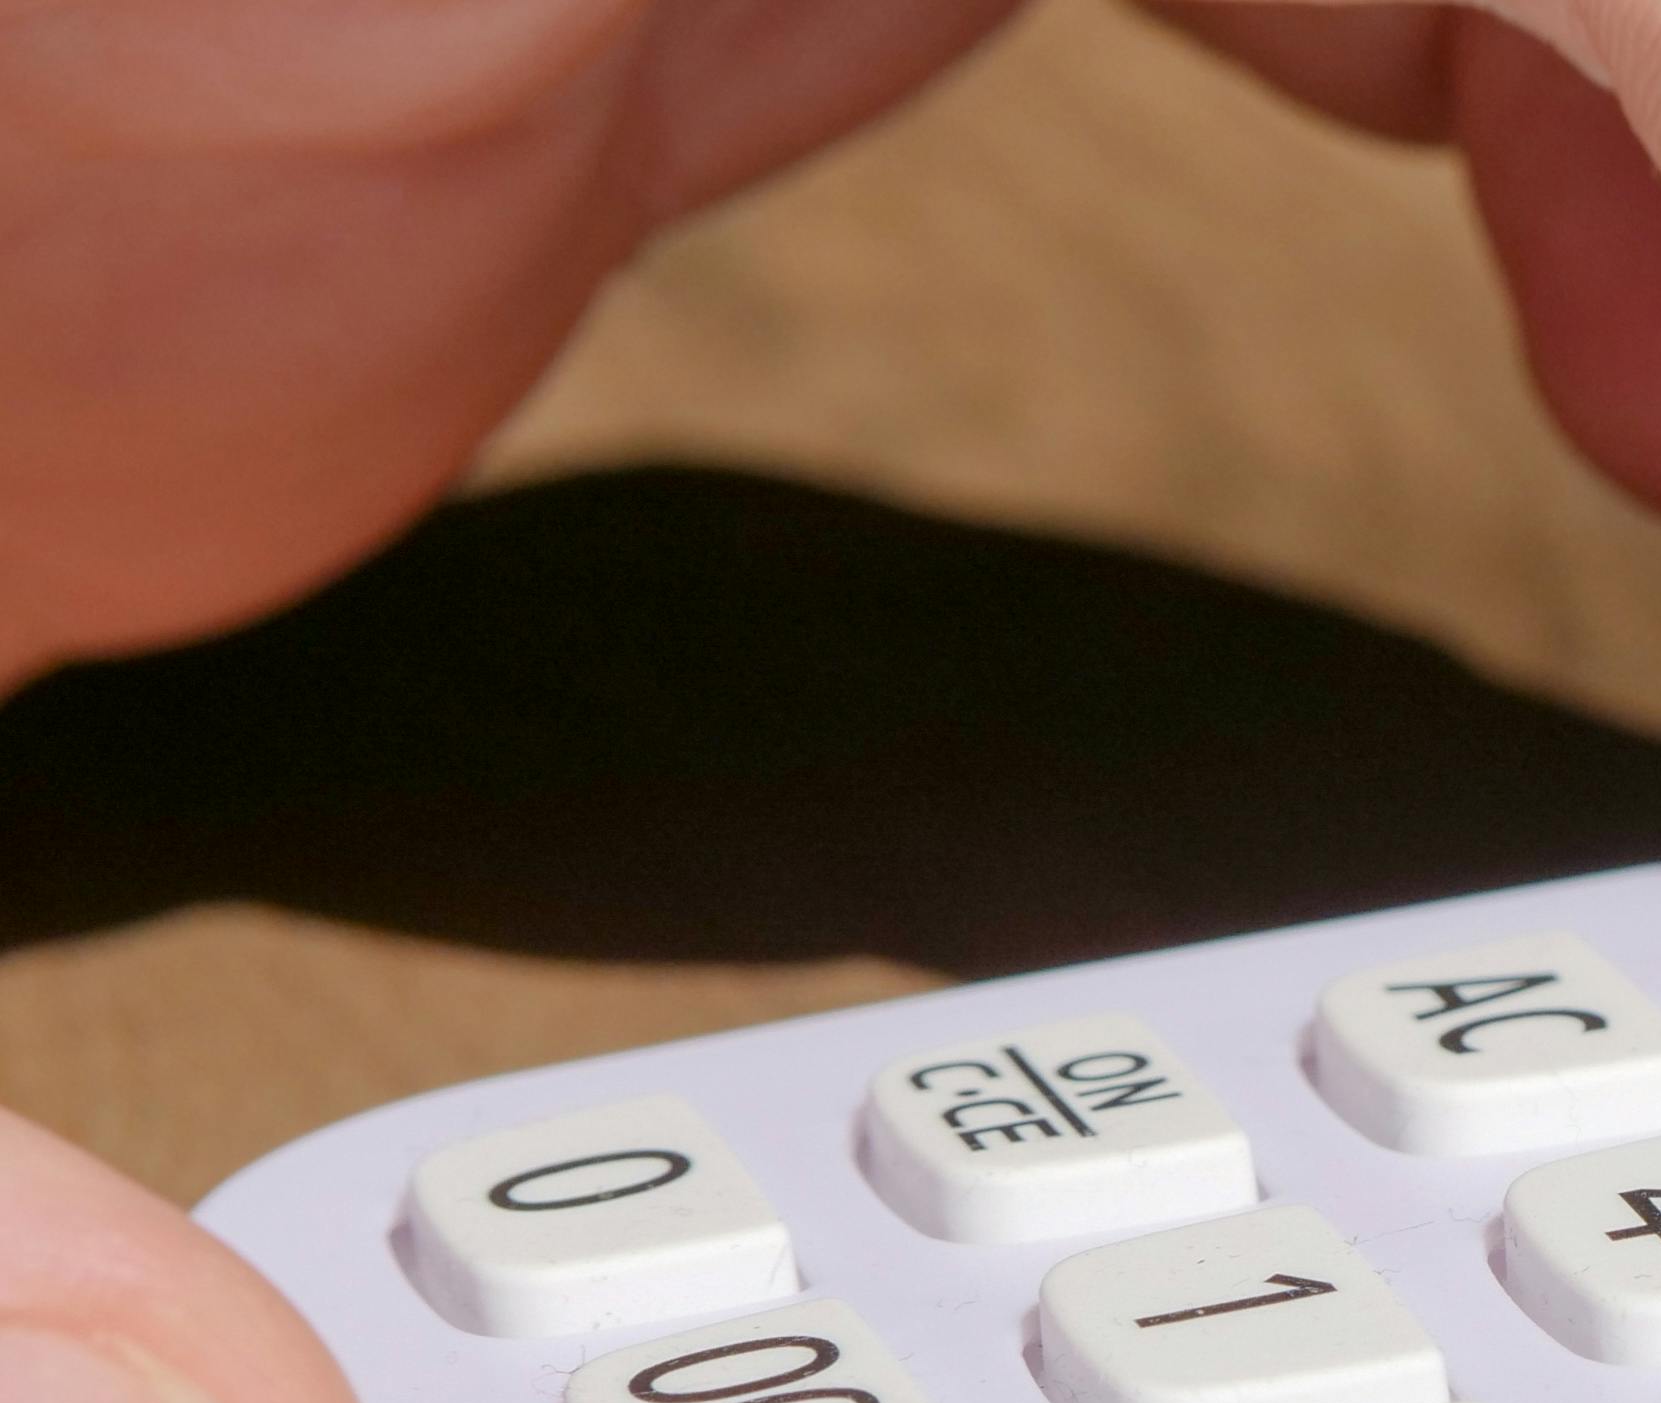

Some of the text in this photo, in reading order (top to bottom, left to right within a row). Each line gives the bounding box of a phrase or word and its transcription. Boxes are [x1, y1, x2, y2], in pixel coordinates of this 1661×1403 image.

[1388, 974, 1608, 1055] AC
[1055, 1051, 1182, 1111] ON
[487, 1149, 692, 1212] 0
[1135, 1273, 1338, 1329] 1
